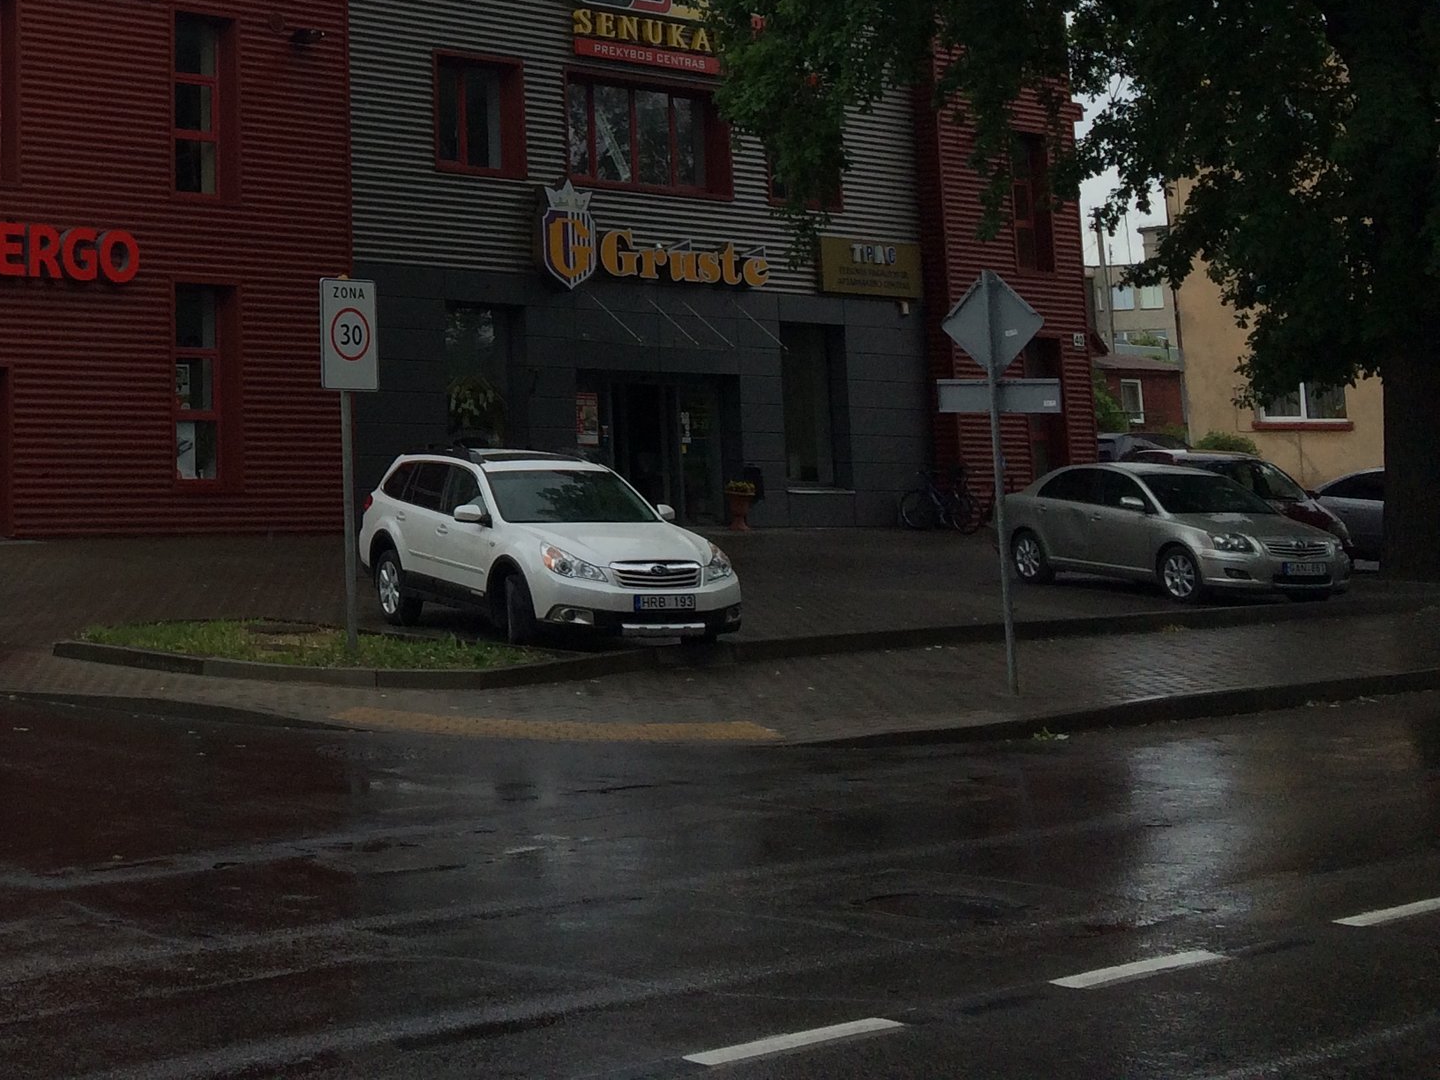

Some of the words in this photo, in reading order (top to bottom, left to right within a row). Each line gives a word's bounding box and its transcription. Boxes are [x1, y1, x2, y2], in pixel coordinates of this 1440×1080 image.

[593, 43, 653, 62] PREKYBOS
[656, 52, 706, 71] CENTRAS
[333, 286, 365, 300] ZONA
[340, 323, 362, 346] 30
[642, 596, 666, 608] HRB
[674, 596, 693, 608] 193
